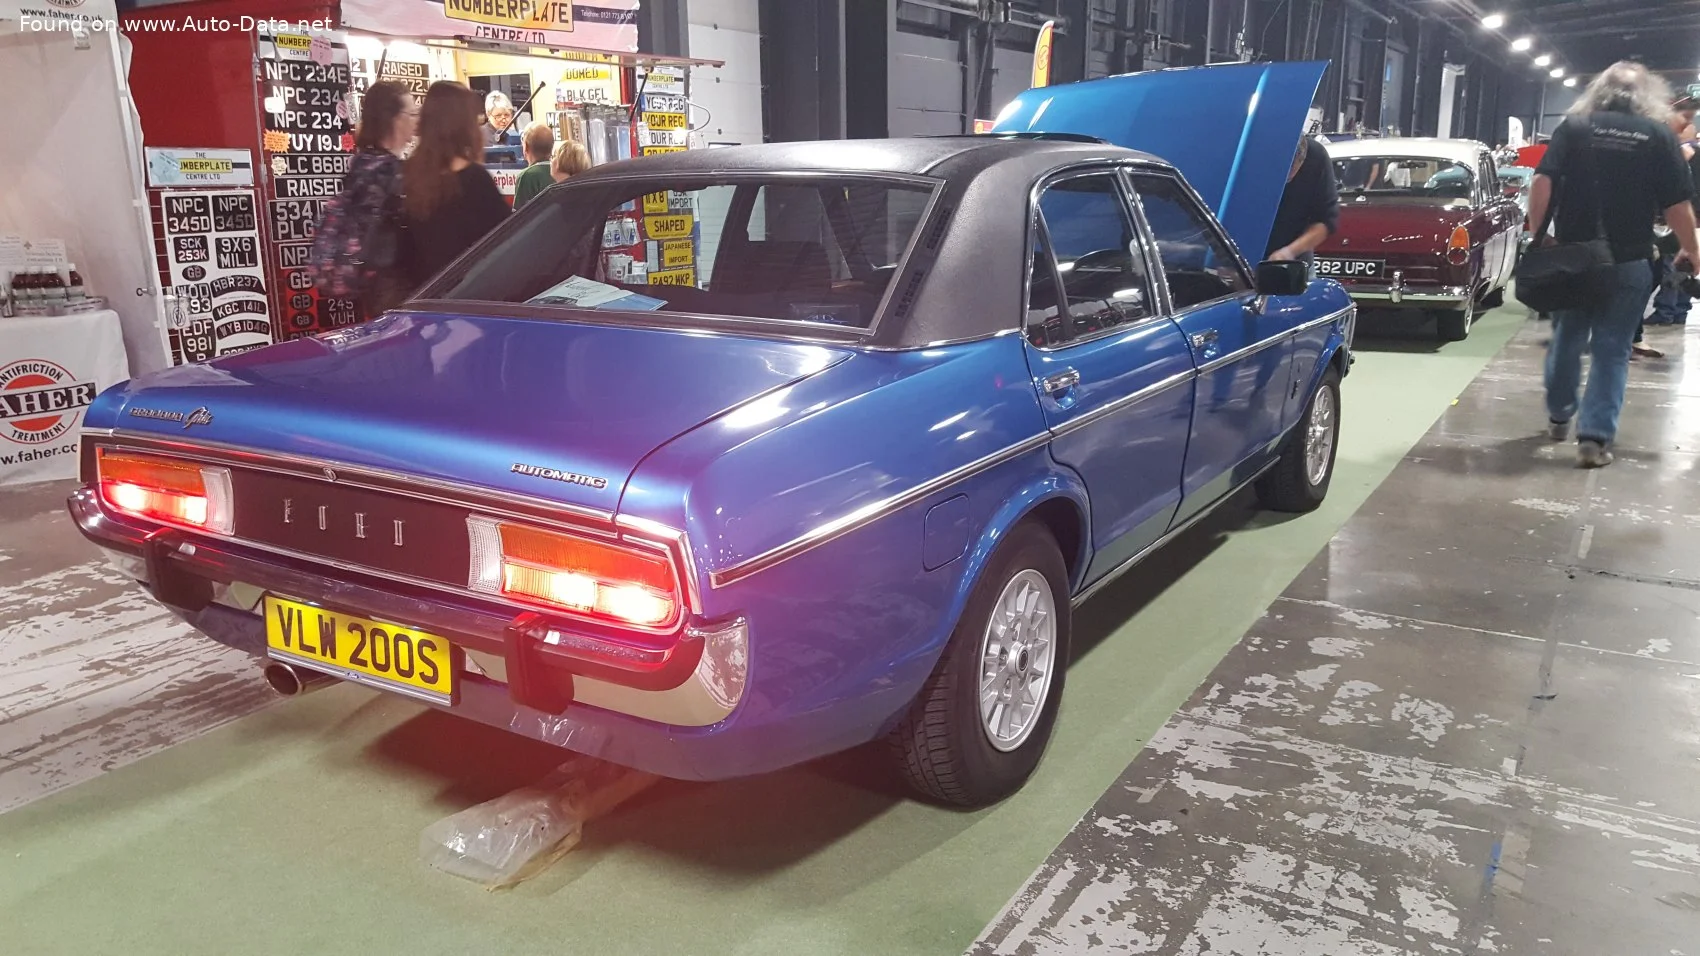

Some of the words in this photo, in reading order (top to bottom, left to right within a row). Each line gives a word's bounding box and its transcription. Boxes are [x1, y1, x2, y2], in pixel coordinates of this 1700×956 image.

[265, 61, 301, 81] NPC
[304, 64, 348, 84] 234E
[382, 61, 423, 77] RAISED
[272, 85, 307, 105] NPC
[310, 87, 341, 106] 234
[273, 110, 308, 129] NPC
[310, 111, 343, 130] 234
[644, 113, 667, 128] YOUR
[667, 115, 684, 128] REG
[287, 132, 314, 152] UY
[648, 132, 667, 145] OUR
[195, 151, 207, 159] THE
[280, 156, 309, 174] LC
[286, 178, 344, 197] RAISED
[172, 197, 205, 214] NPC
[218, 196, 248, 212] NPC
[275, 201, 314, 221] 534
[168, 215, 211, 233] 345D
[215, 213, 255, 231] 345D
[277, 219, 314, 240] PLG
[654, 219, 686, 233] SHAPED
[180, 237, 202, 250] SCK
[221, 237, 252, 253] 9X6
[664, 241, 691, 251] JAPANESE
[177, 248, 208, 262] 253K
[220, 252, 256, 268] MILL
[668, 255, 688, 264] IMPORT
[186, 266, 202, 279] GB
[1344, 262, 1376, 276] UPC
[290, 271, 313, 290] GB
[292, 293, 312, 309] GB
[216, 302, 240, 318] KGC
[329, 310, 356, 326] YUH
[296, 315, 310, 326] GB
[11, 421, 66, 442] TREATMENT
[511, 463, 609, 491] AUTOMATIC
[276, 603, 338, 661] VLW
[346, 621, 440, 686] 200S
